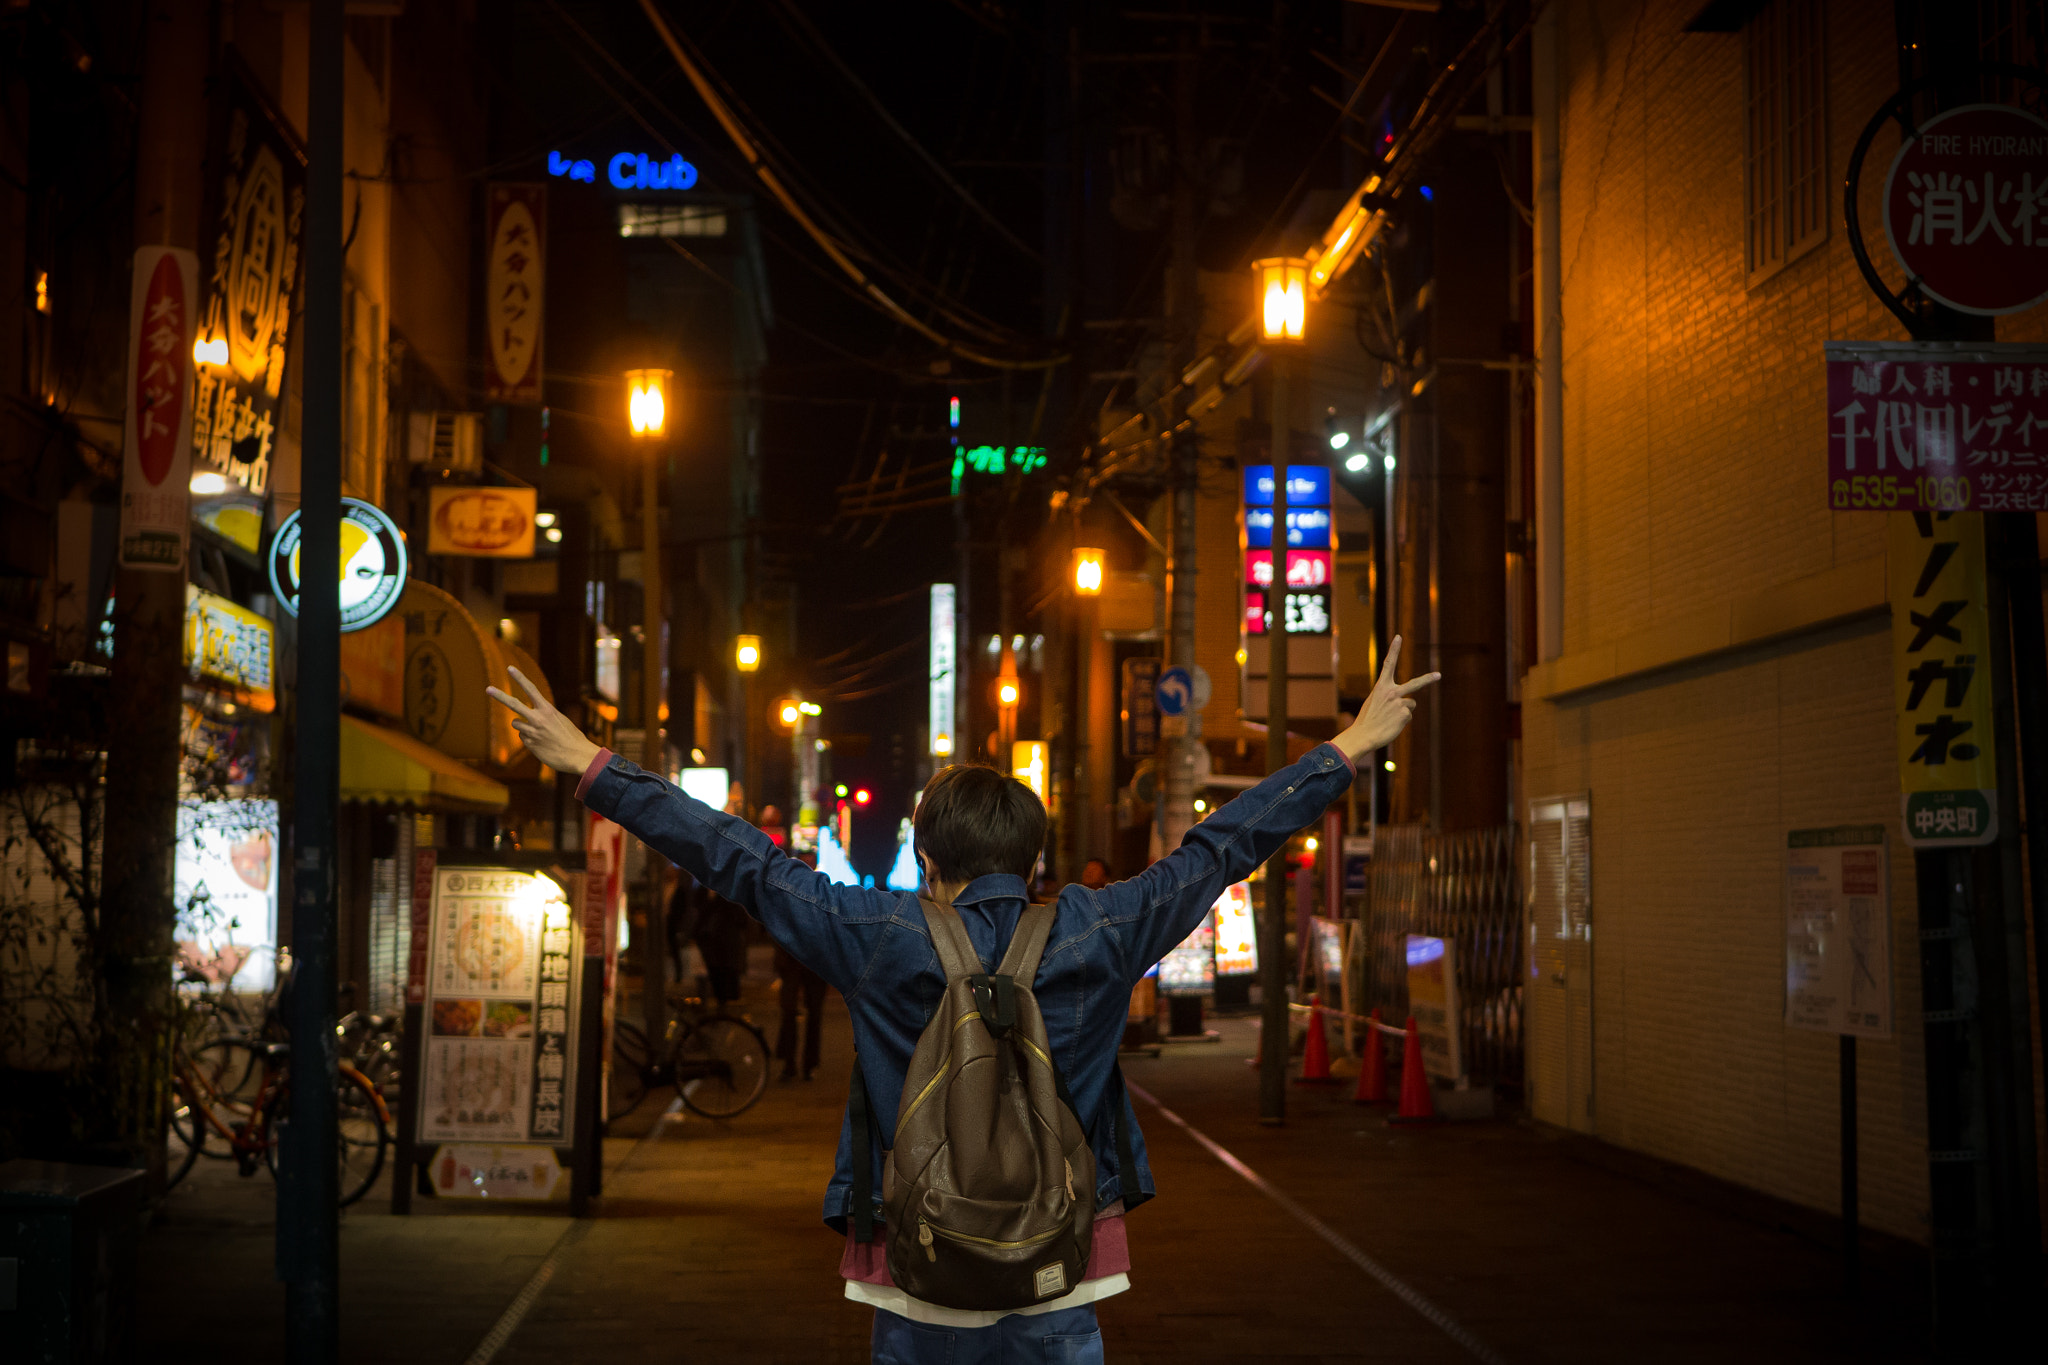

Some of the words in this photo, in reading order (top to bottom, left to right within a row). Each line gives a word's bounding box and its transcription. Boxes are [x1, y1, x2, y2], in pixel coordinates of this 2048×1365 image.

[1921, 135, 1962, 156] FIRE
[607, 152, 698, 190] Club
[1906, 170, 2048, 247] 消火栓
[140, 295, 181, 441] 大分ハット
[1851, 476, 1971, 507] 535-1060
[1978, 493, 2048, 509] コスモビ
[1914, 805, 1978, 835] 中央町
